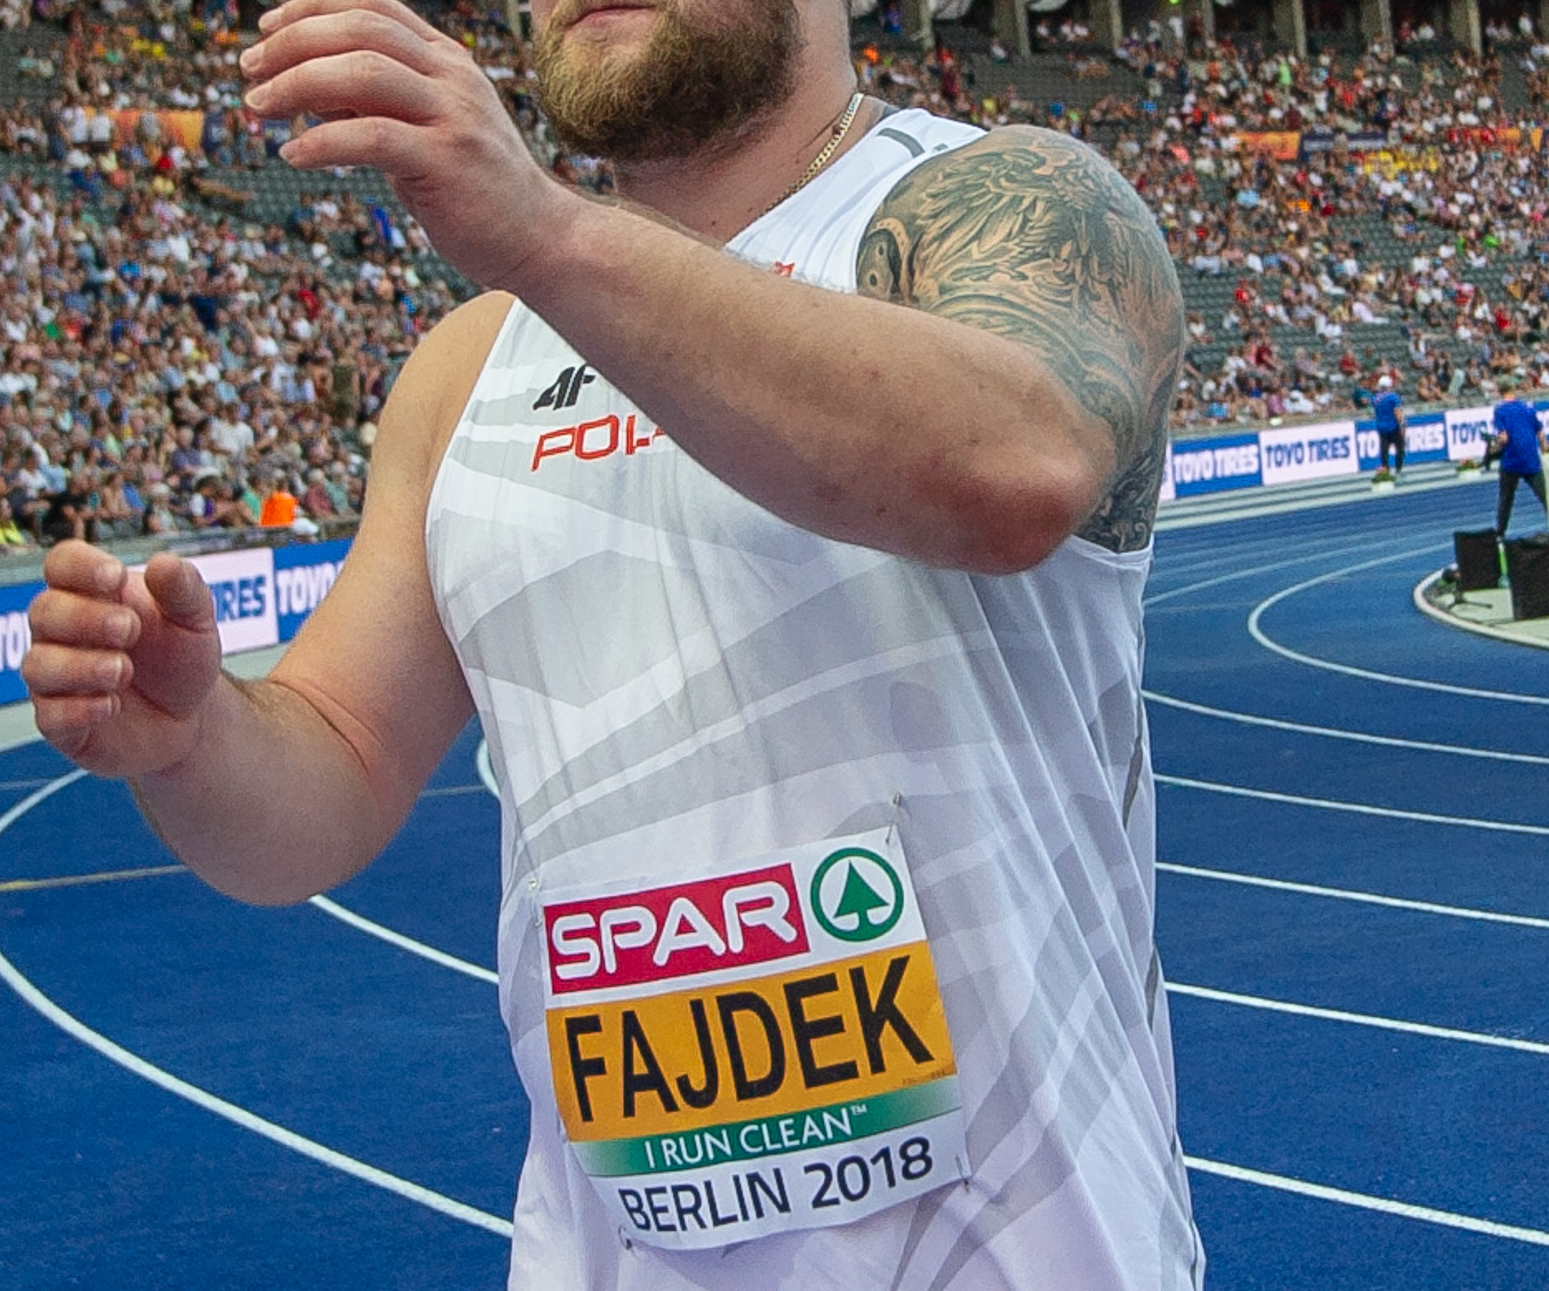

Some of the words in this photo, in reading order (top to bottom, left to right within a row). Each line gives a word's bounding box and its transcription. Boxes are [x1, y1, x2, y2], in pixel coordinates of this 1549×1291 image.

[531, 413, 666, 472] POL
[1174, 449, 1213, 484] TOYO
[1265, 442, 1303, 469] TOYO
[1308, 436, 1350, 462] TIRES
[209, 575, 266, 622] IRES
[551, 879, 799, 981] SPAR
[564, 954, 936, 1124] FAJDEK
[644, 1140, 655, 1169] I
[661, 1128, 733, 1168] RUN
[617, 1167, 792, 1234] BERLIN
[803, 1135, 935, 1209] 2018
